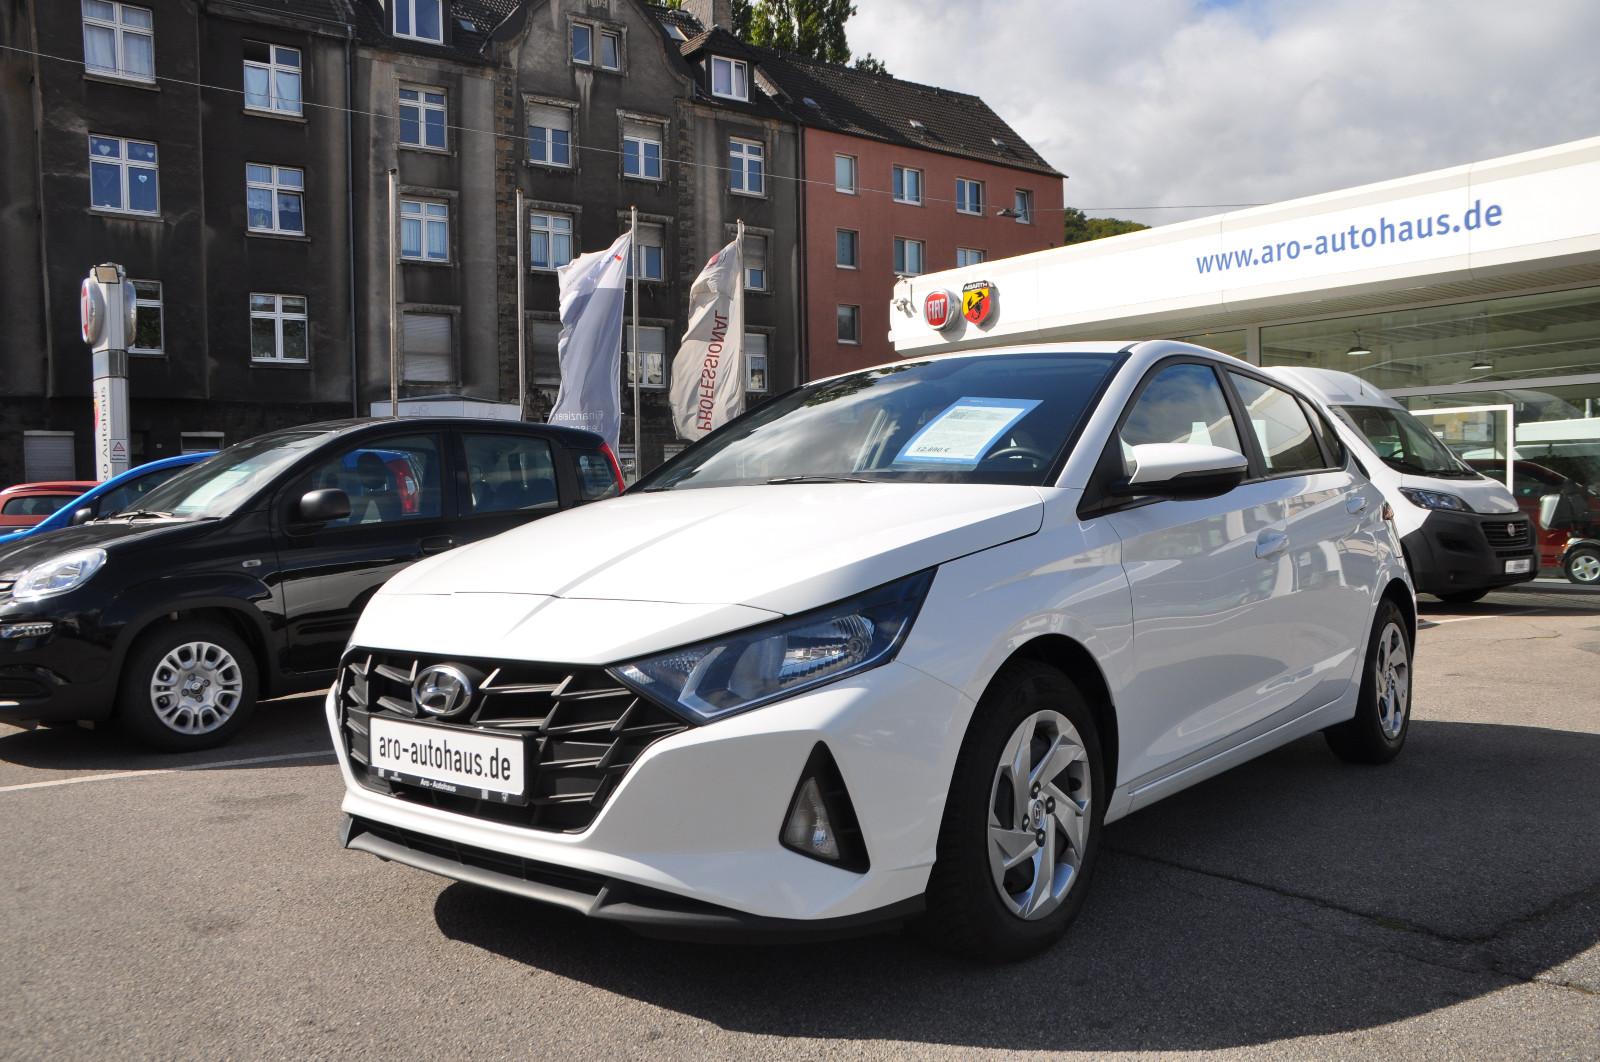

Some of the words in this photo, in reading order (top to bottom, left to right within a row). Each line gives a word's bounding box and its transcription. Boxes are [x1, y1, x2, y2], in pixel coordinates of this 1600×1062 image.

[1196, 199, 1503, 274] www.aro-autohaus.de
[963, 281, 988, 290] ABARTH
[927, 298, 946, 320] FIAT
[379, 735, 511, 782] aro-autohaus.de
